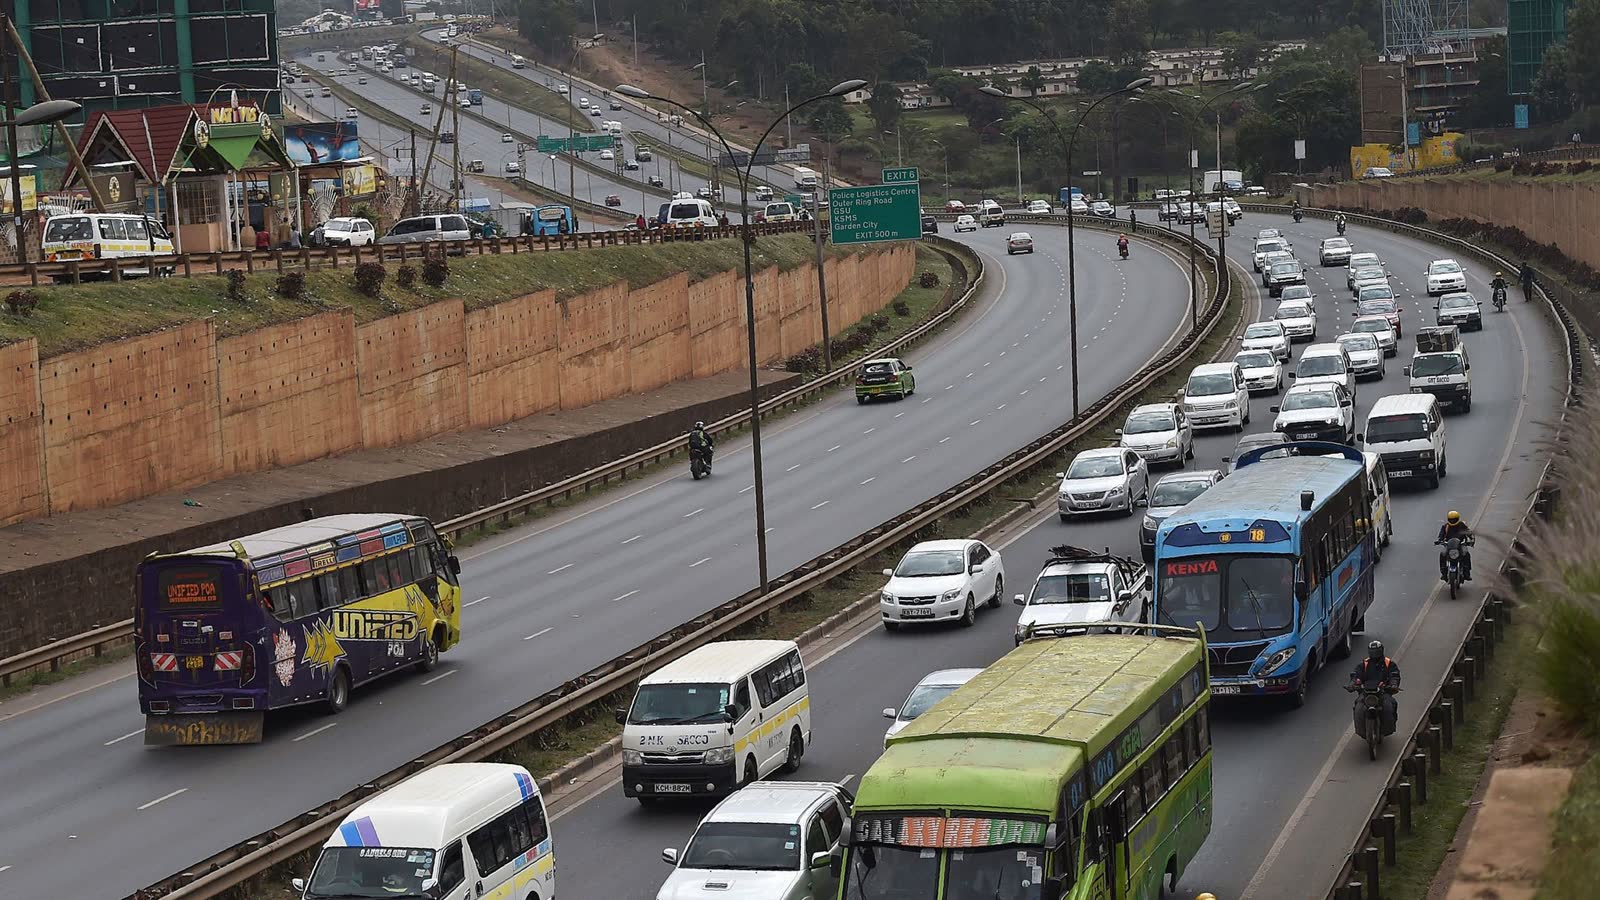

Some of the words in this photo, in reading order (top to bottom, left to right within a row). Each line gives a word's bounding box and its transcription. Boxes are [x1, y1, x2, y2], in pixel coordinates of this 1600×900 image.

[887, 172, 907, 180] EXIT
[909, 171, 915, 179] 6
[856, 189, 889, 198] Logistics
[891, 188, 916, 196] Centre
[855, 198, 872, 206] Ring
[833, 207, 851, 215] GSU
[834, 215, 857, 223] KSMS
[834, 222, 861, 230] Garden
[863, 221, 878, 229] City
[875, 230, 890, 238] 500
[1251, 529, 1265, 541] 18
[1167, 560, 1219, 576] KENYA
[168, 583, 200, 598] UNIFIED
[200, 583, 216, 595] POA
[334, 612, 418, 639] UNIFIED
[181, 637, 207, 645] ISUZU
[387, 642, 405, 657] POA
[677, 734, 709, 746] SACCO
[655, 784, 670, 793] KCH
[856, 818, 942, 847] GALAXY
[945, 818, 1042, 847] REBORN
